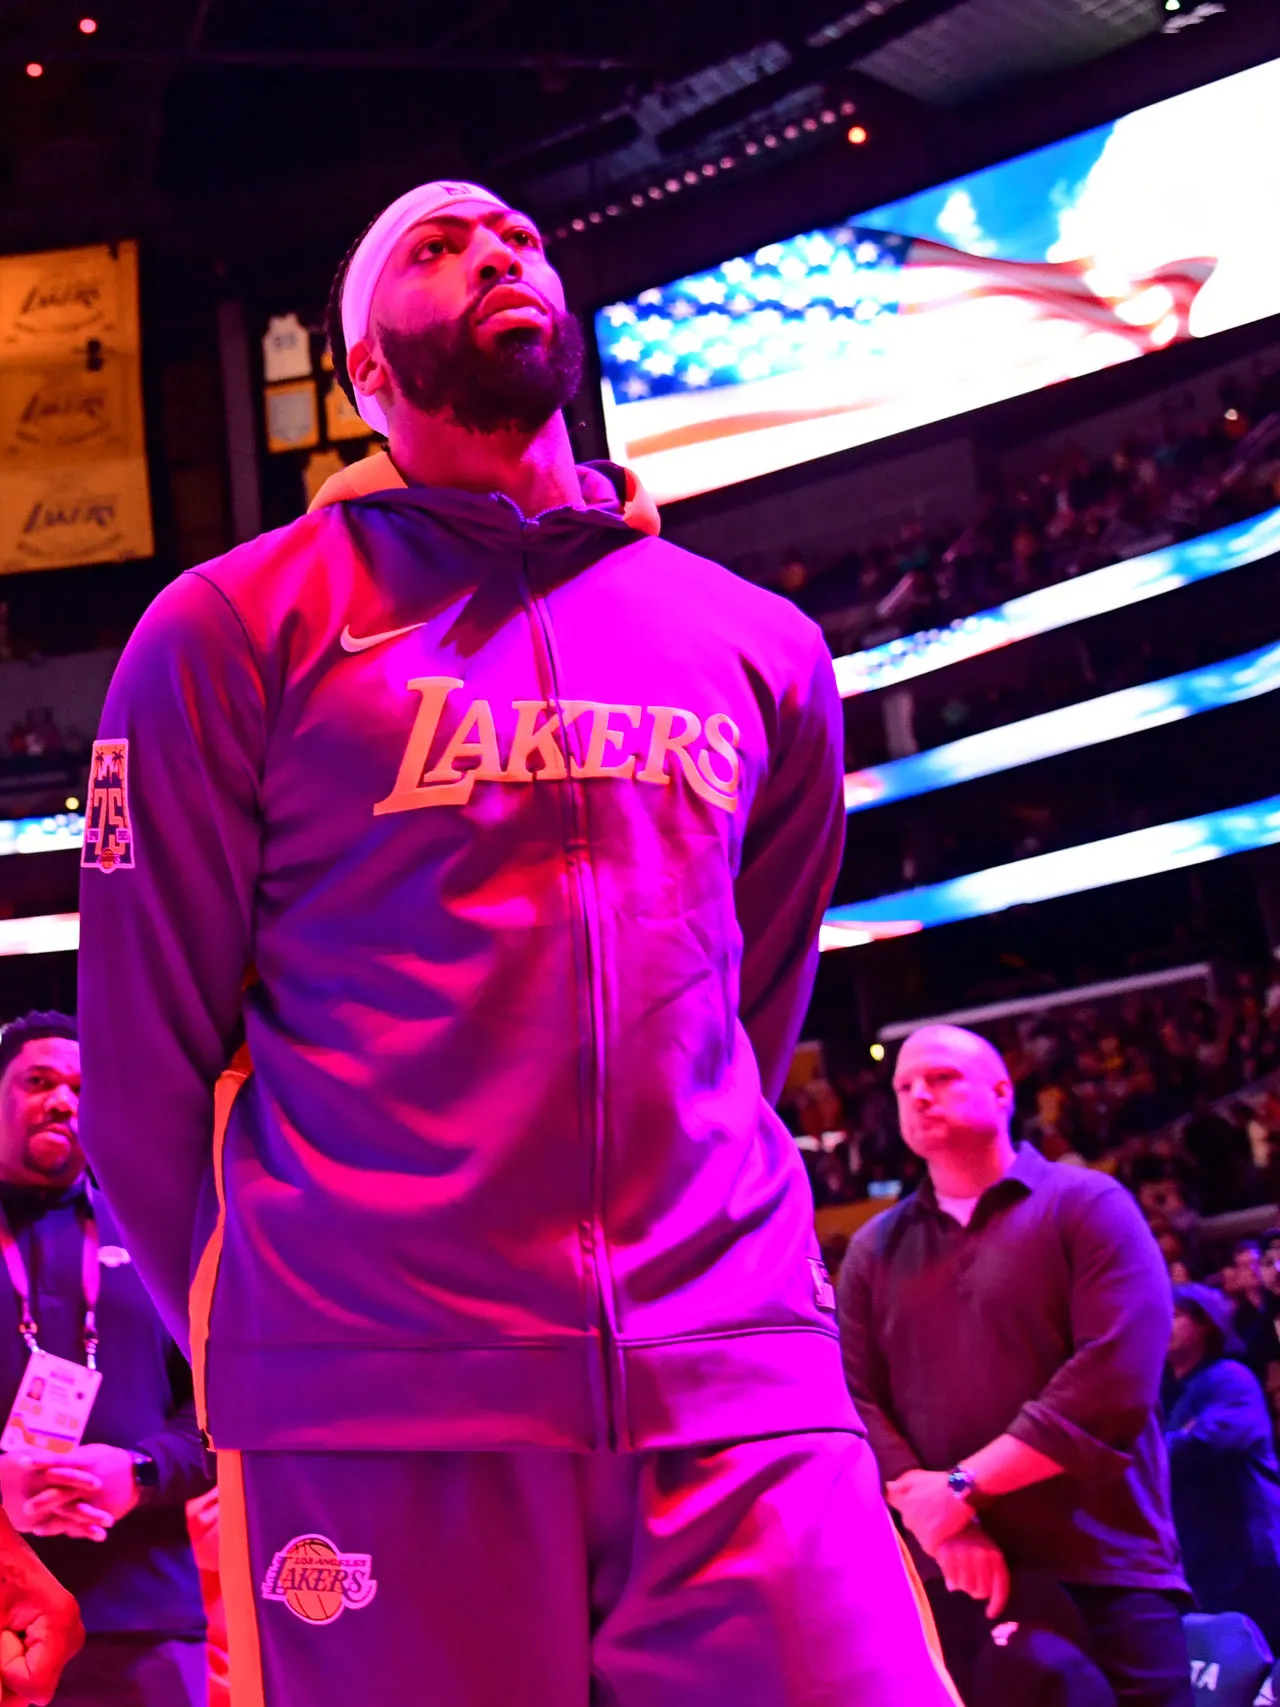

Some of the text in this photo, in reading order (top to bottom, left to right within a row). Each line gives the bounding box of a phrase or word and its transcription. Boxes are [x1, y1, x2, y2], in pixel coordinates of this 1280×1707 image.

[373, 676, 740, 816] LAKERS
[94, 788, 126, 855] 75
[271, 1555, 374, 1604] LAKERS
[294, 1557, 365, 1567] LOS ANGELES
